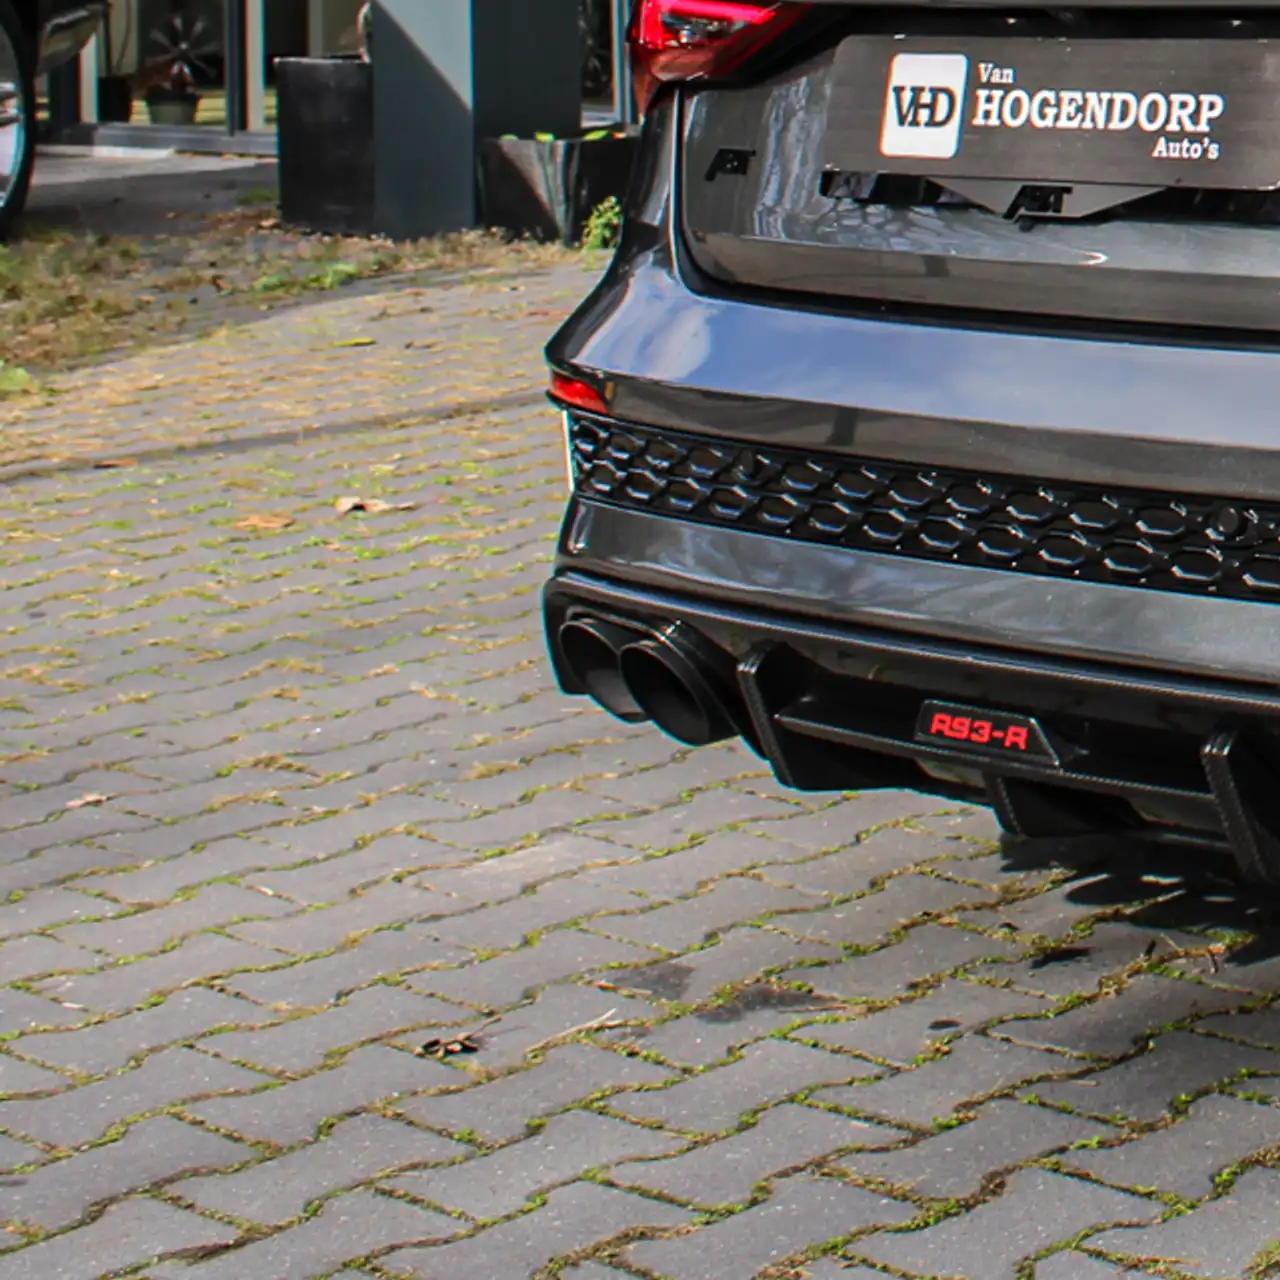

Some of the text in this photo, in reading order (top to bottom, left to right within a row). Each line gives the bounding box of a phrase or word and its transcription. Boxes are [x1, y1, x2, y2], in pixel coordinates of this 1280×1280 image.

[977, 61, 1015, 83] Van
[890, 83, 957, 128] VHD
[971, 88, 1226, 134] HOGENDORP
[1150, 135, 1221, 161] Auto's
[929, 712, 1030, 751] RS3-R
